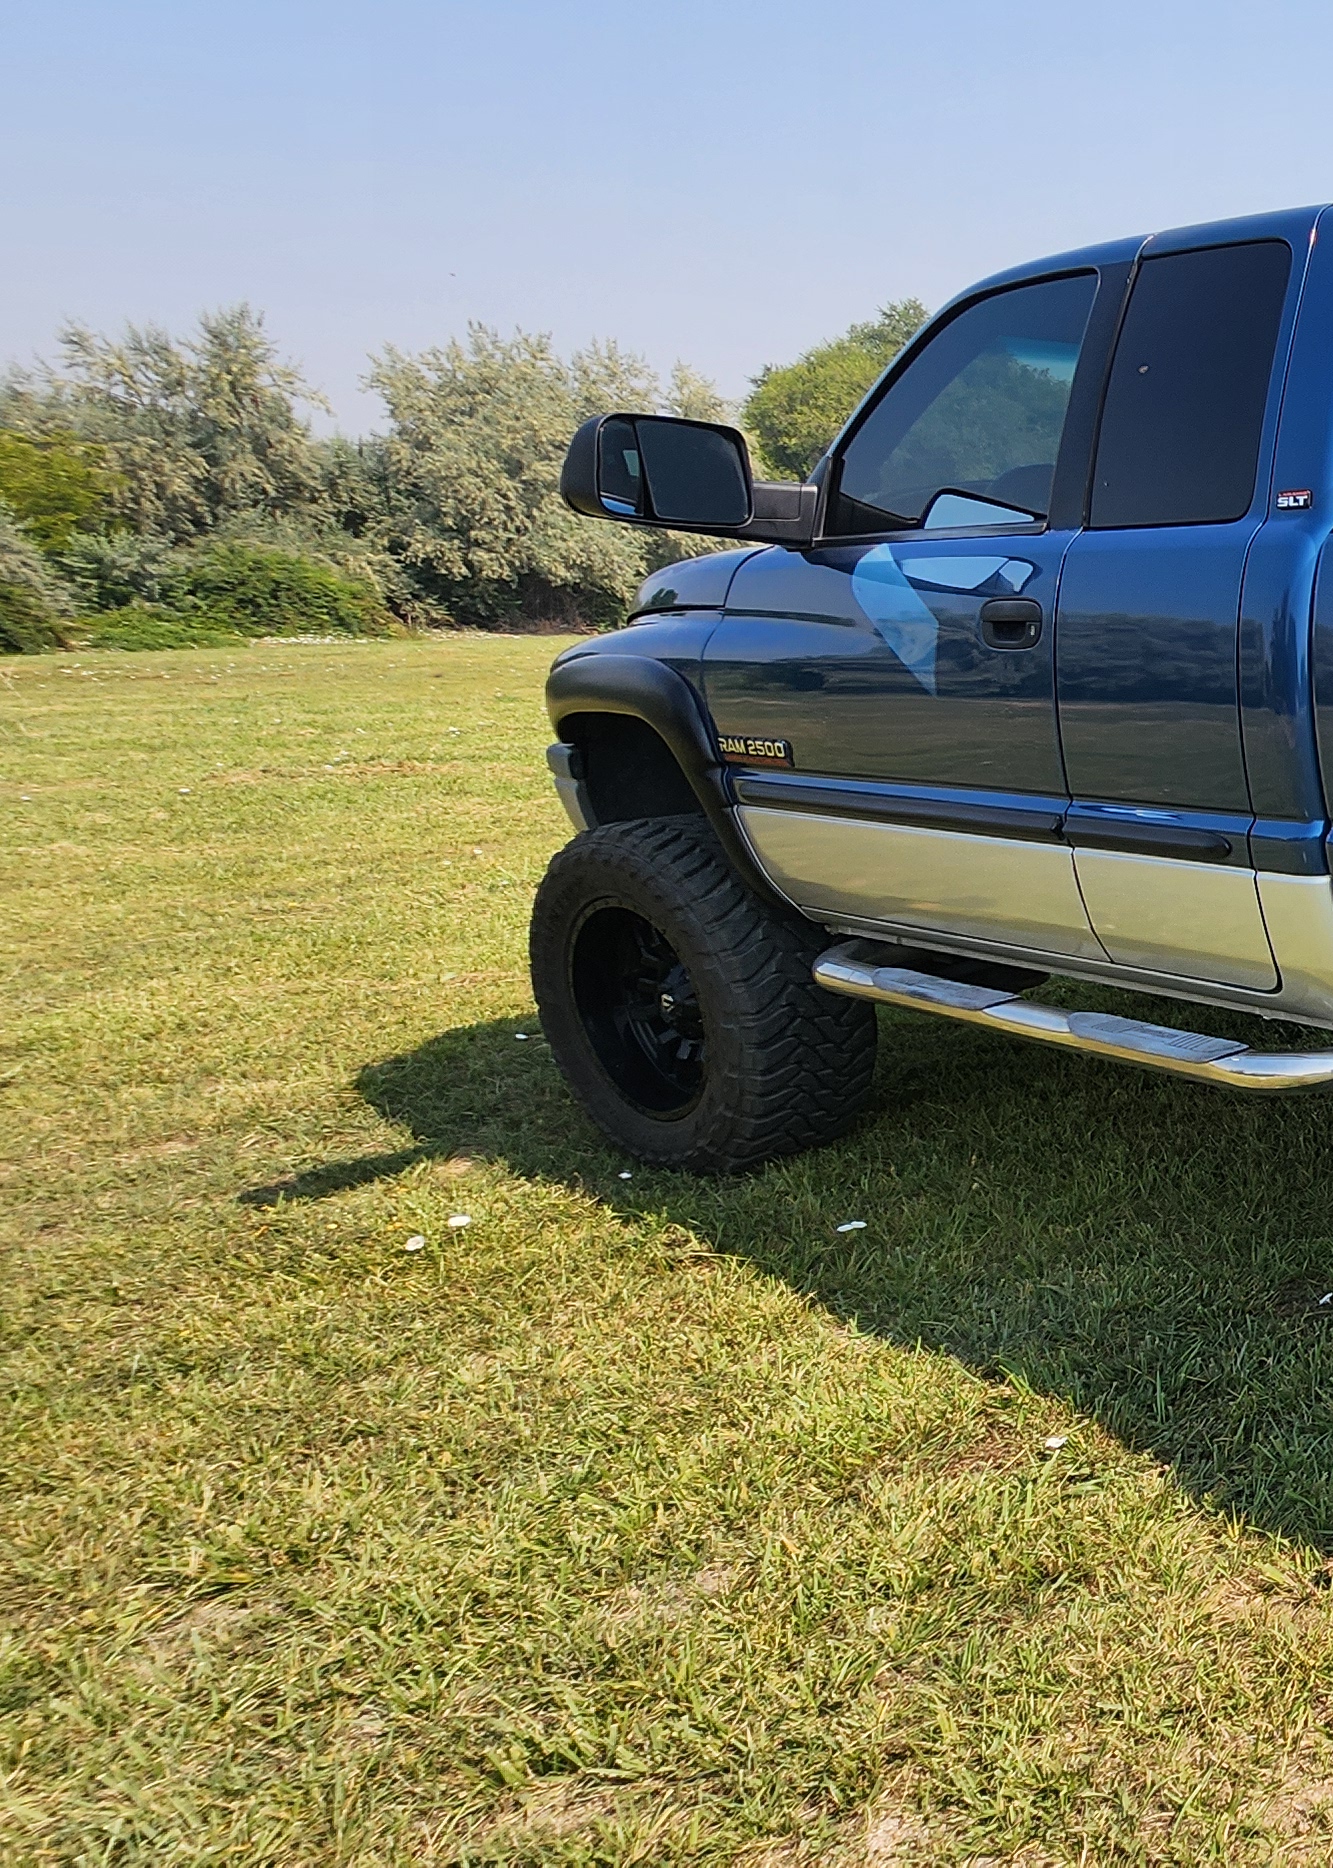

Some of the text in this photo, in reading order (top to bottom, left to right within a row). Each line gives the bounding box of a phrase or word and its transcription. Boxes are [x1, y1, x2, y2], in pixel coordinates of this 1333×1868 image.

[1276, 495, 1309, 508] SLT
[718, 737, 786, 758] RAM 2500
